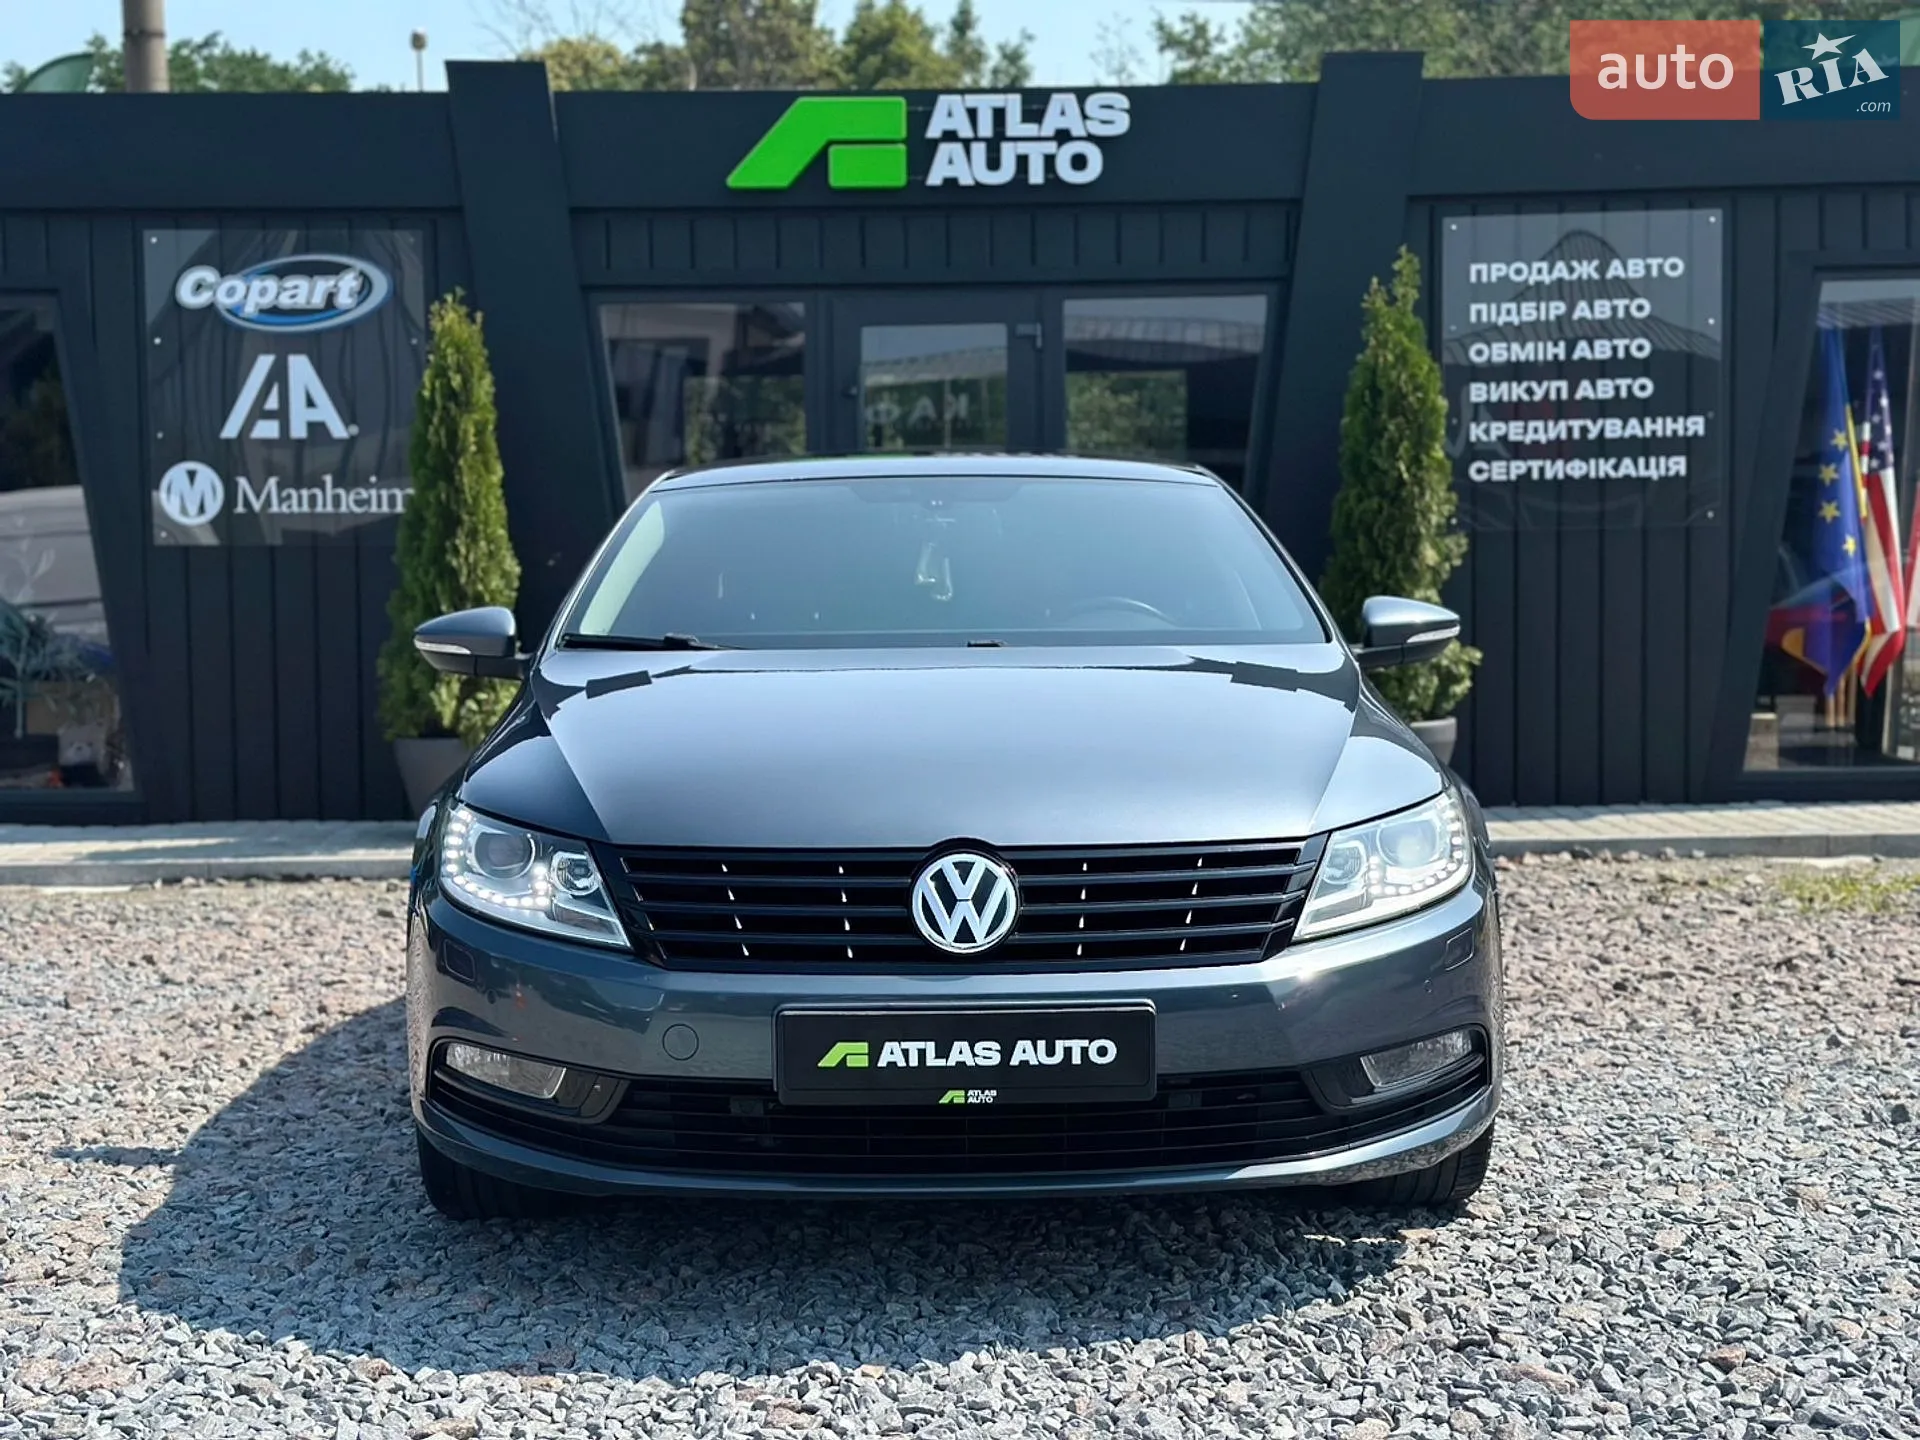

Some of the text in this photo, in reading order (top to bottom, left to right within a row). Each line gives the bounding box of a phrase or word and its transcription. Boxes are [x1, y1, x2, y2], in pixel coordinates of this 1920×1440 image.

[925, 92, 1131, 139] ATLAS
[925, 141, 1104, 187] AUTO
[1468, 256, 1686, 285] ПРОДАЖ АВТО
[176, 265, 361, 318] Copart
[1468, 297, 1652, 326] ПІДБІР АВТО
[1467, 337, 1653, 364] ОБМІН АВТО
[1468, 377, 1656, 404] ВИКУП АВТО
[1468, 415, 1706, 444] КРЕДИТУВАННЯ
[1467, 455, 1688, 483] СЕРТИФІКАЦІЯ
[877, 1038, 1117, 1068] ATLAS AUTO
[967, 1096, 994, 1104] AUTO
